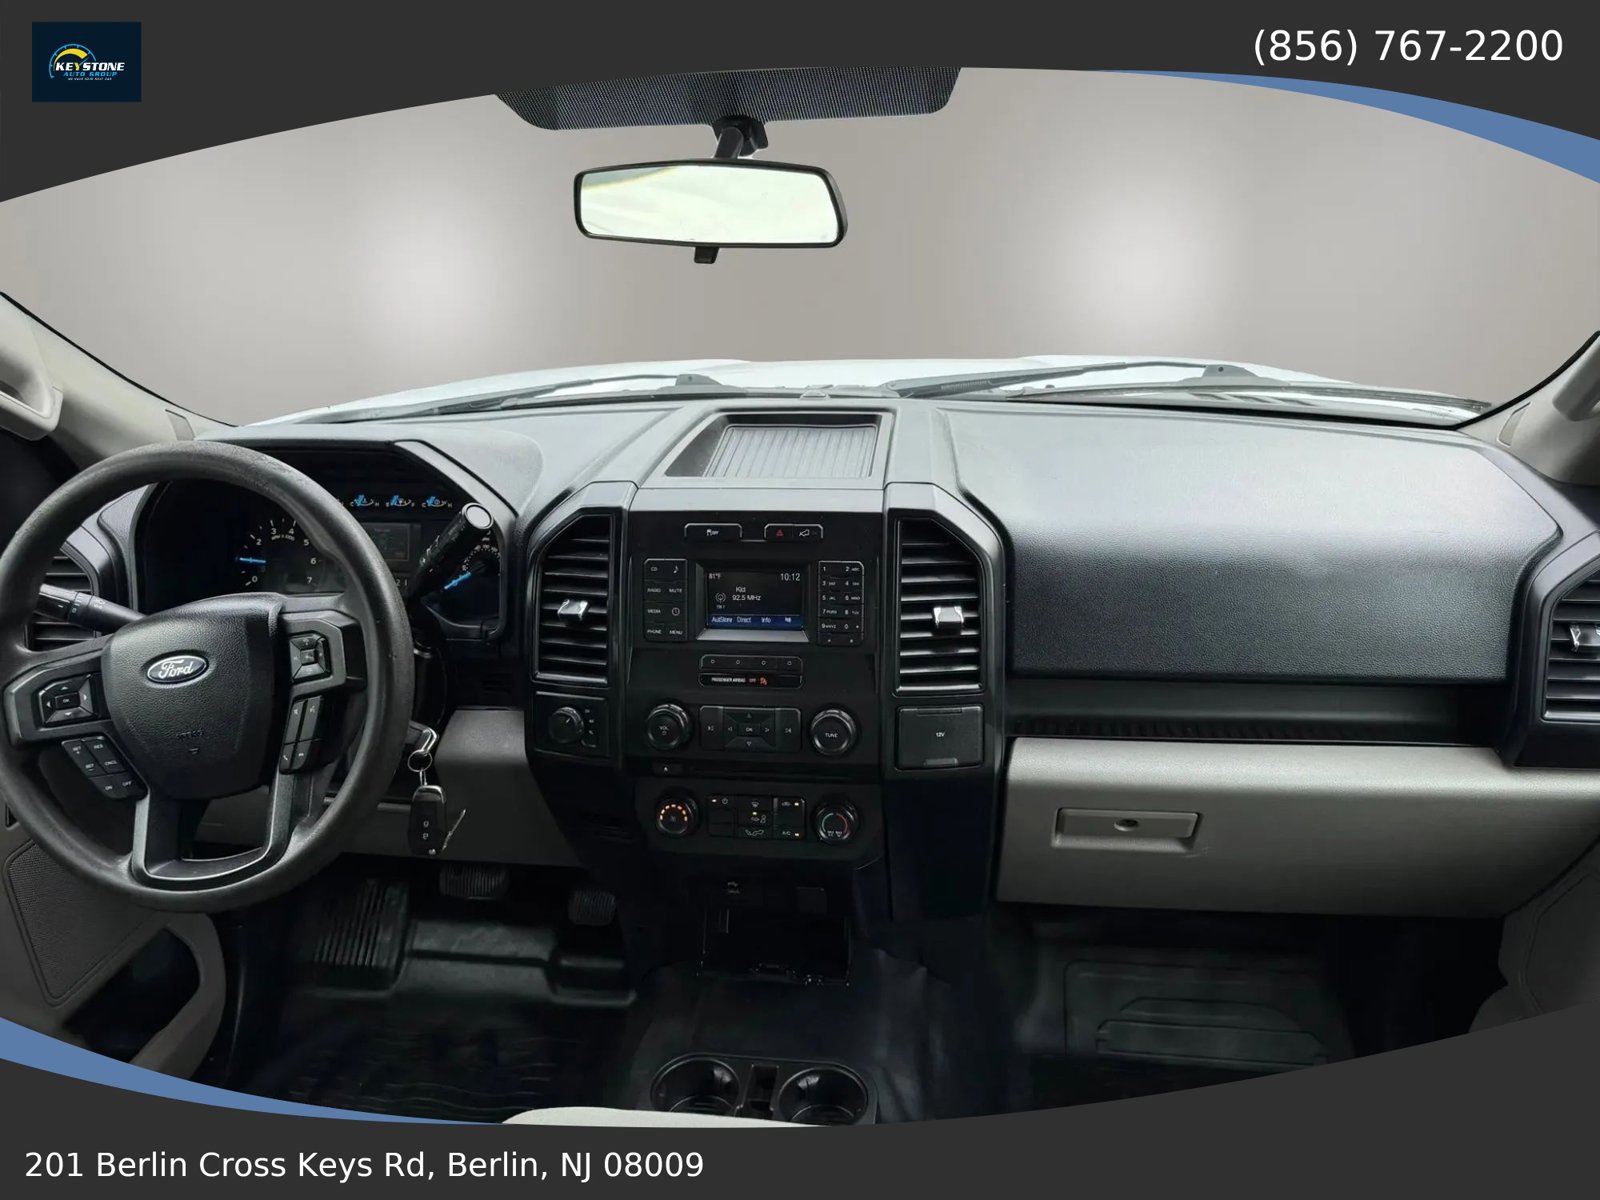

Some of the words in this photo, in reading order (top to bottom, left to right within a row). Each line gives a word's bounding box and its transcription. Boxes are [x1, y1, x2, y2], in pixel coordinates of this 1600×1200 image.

[256, 538, 262, 546] 2
[303, 538, 310, 546] 5
[310, 557, 317, 565] 6
[251, 575, 258, 583] 0
[307, 576, 313, 584] 7
[780, 572, 801, 582] 10:12
[158, 659, 194, 679] Ford
